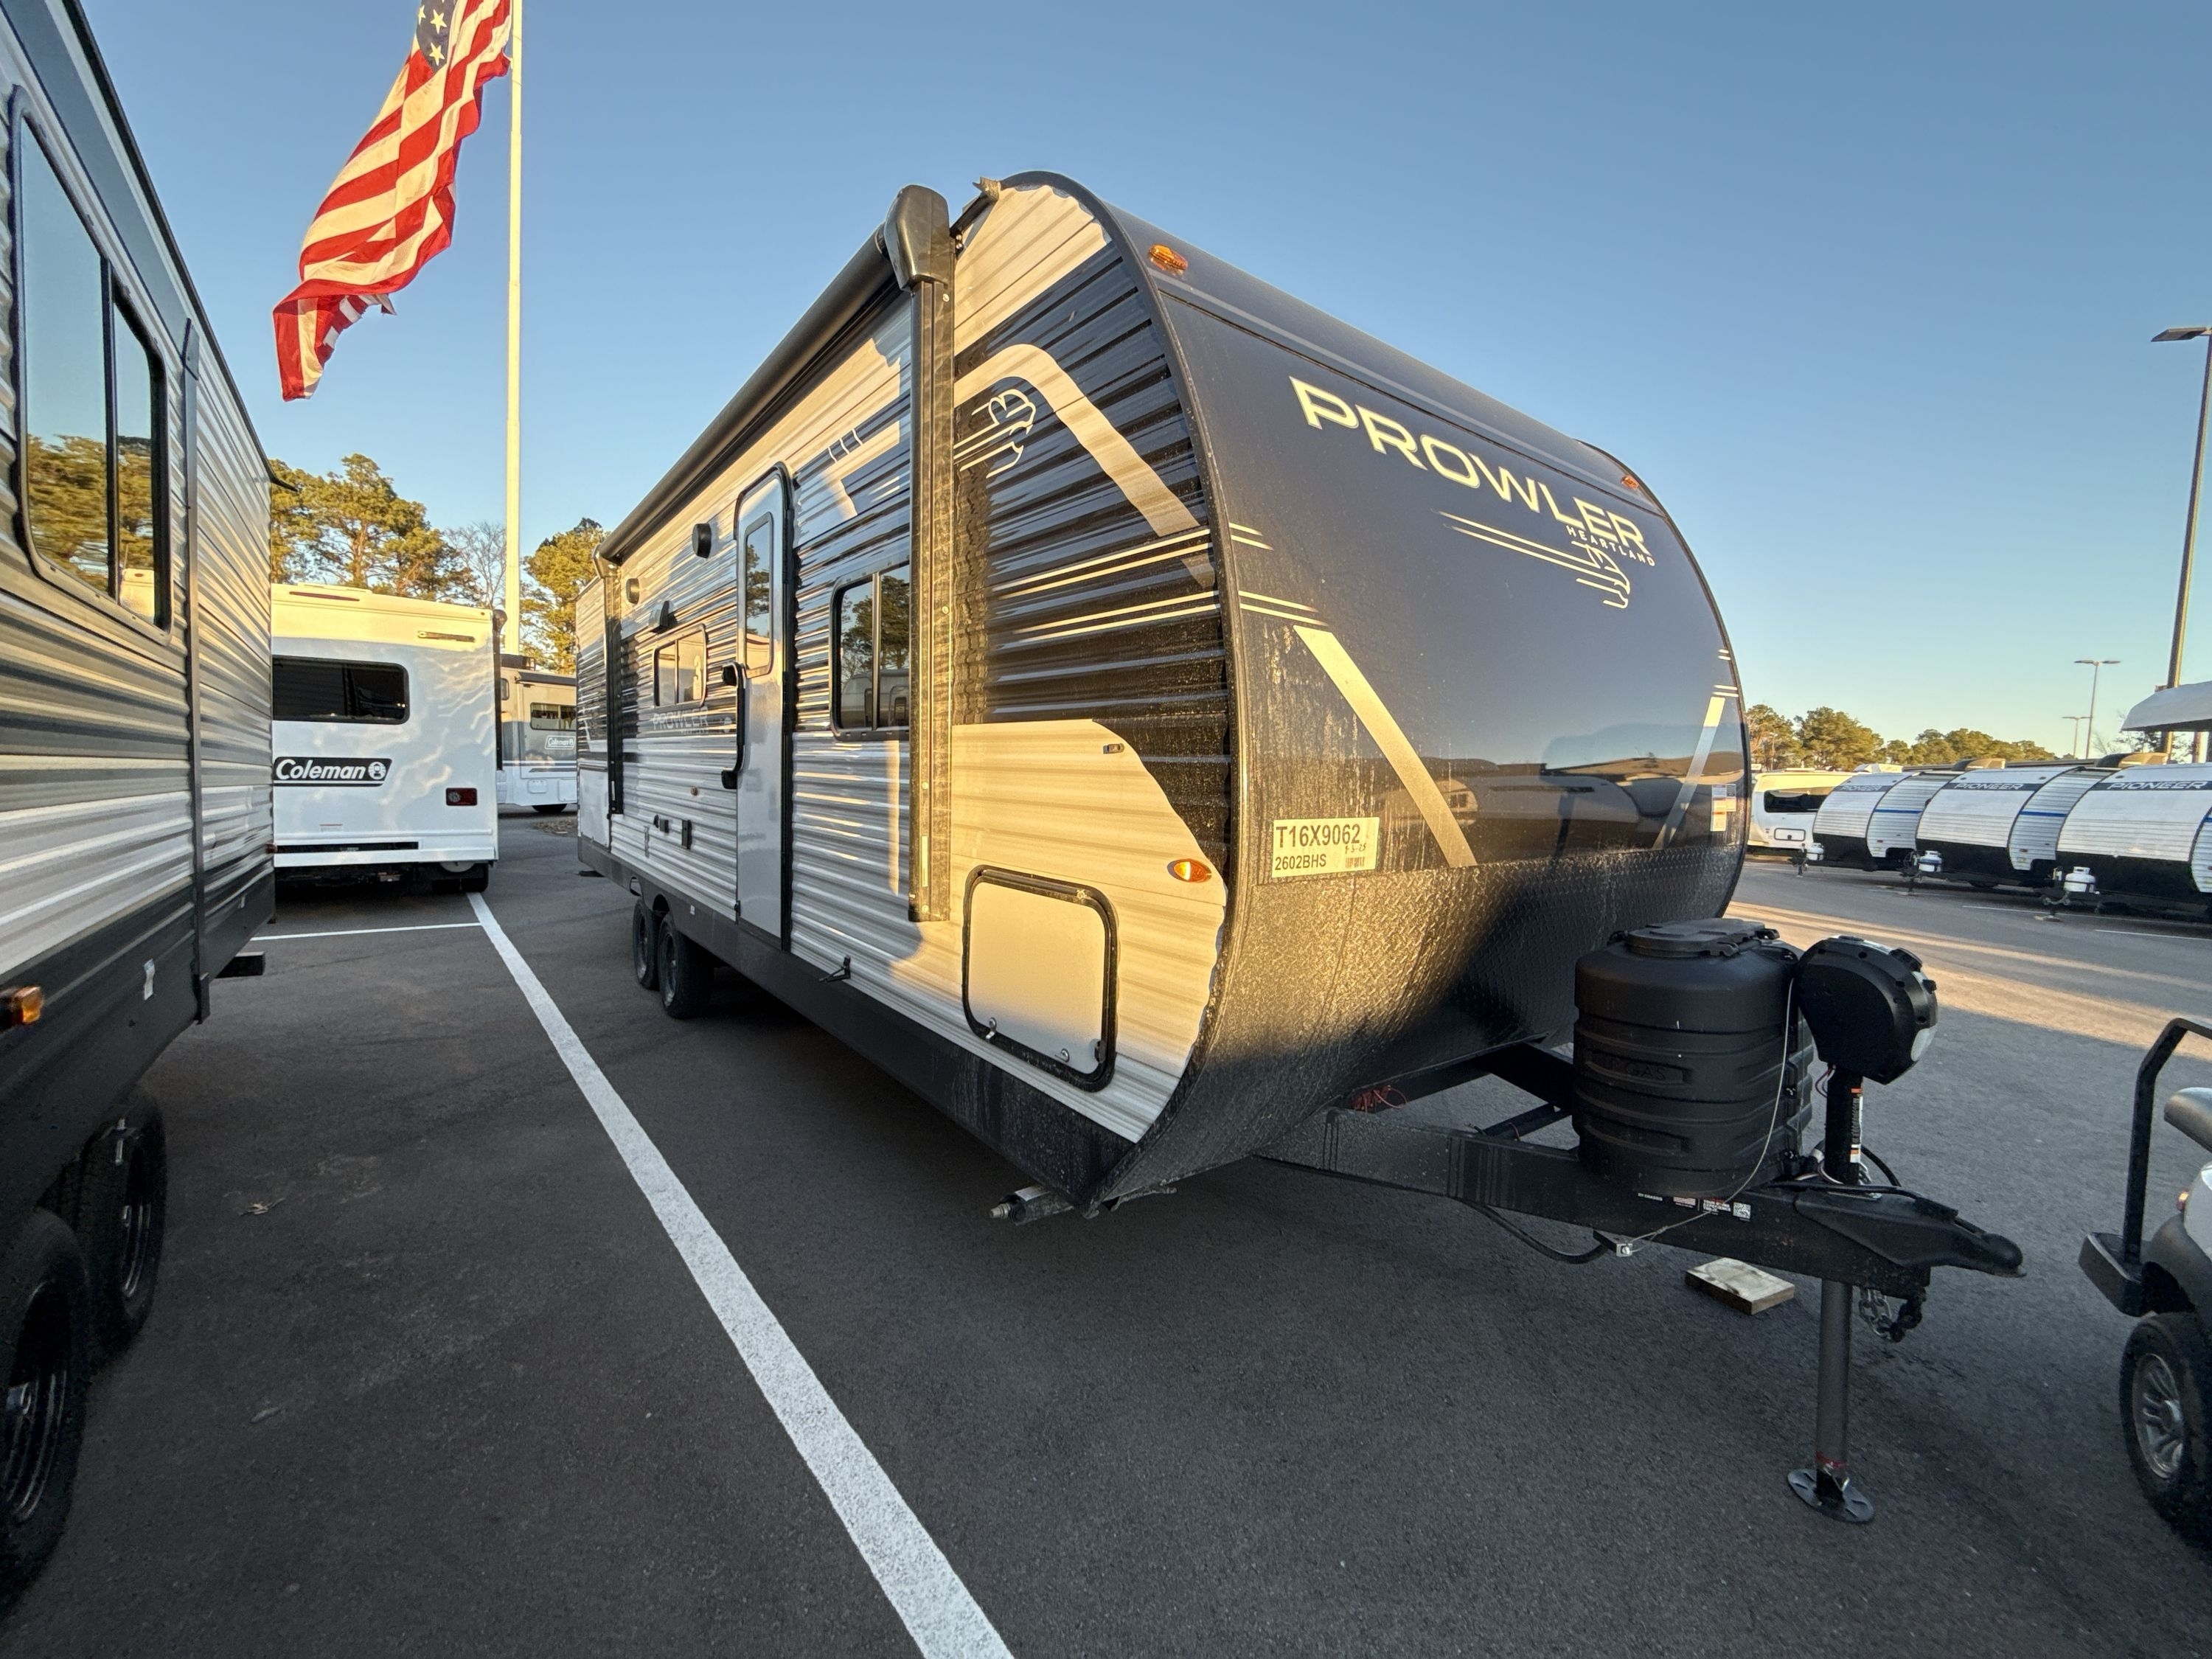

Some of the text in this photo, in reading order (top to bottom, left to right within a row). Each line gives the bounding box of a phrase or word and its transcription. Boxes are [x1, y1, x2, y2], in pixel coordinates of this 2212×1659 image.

[1289, 375, 1653, 557] PROWLER
[1565, 525, 1655, 567] HEARTLAND
[653, 706, 709, 731] PROWLER
[276, 759, 366, 780] Coleman
[2107, 781, 2208, 790] PIONEER
[1276, 824, 1361, 848] T16X9062
[1275, 853, 1327, 871] 2602BHS
